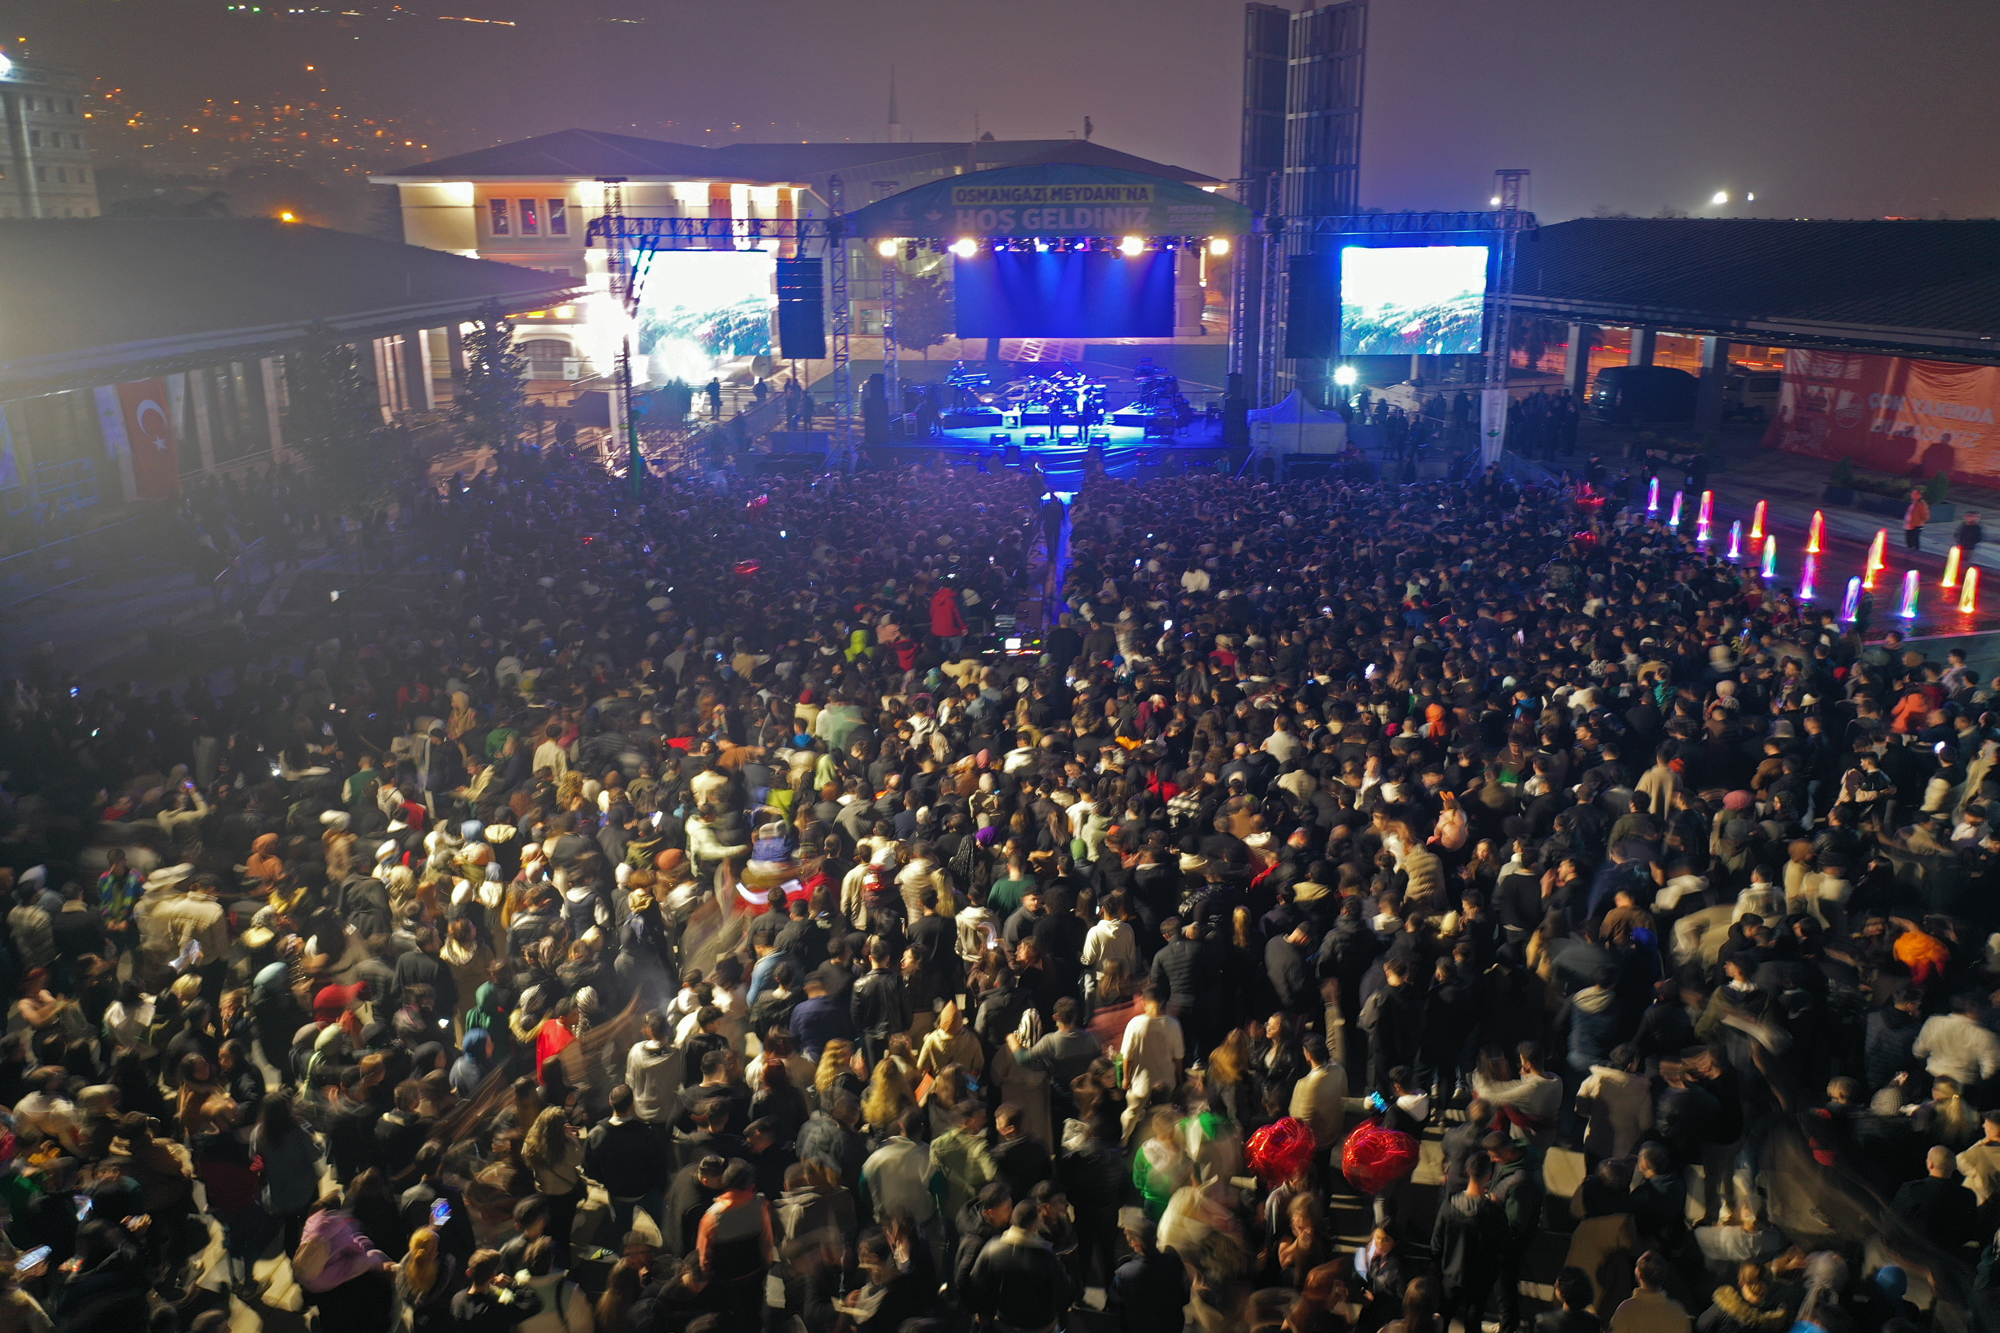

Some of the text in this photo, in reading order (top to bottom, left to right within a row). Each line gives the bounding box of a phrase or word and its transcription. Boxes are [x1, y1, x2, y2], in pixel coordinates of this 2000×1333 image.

[956, 187, 1149, 202] OSMANGAZİ MEYDANI'NA
[956, 207, 1150, 234] HOŞ GELDİNİZ
[1868, 393, 1994, 424] ÇOK YAKINDA
